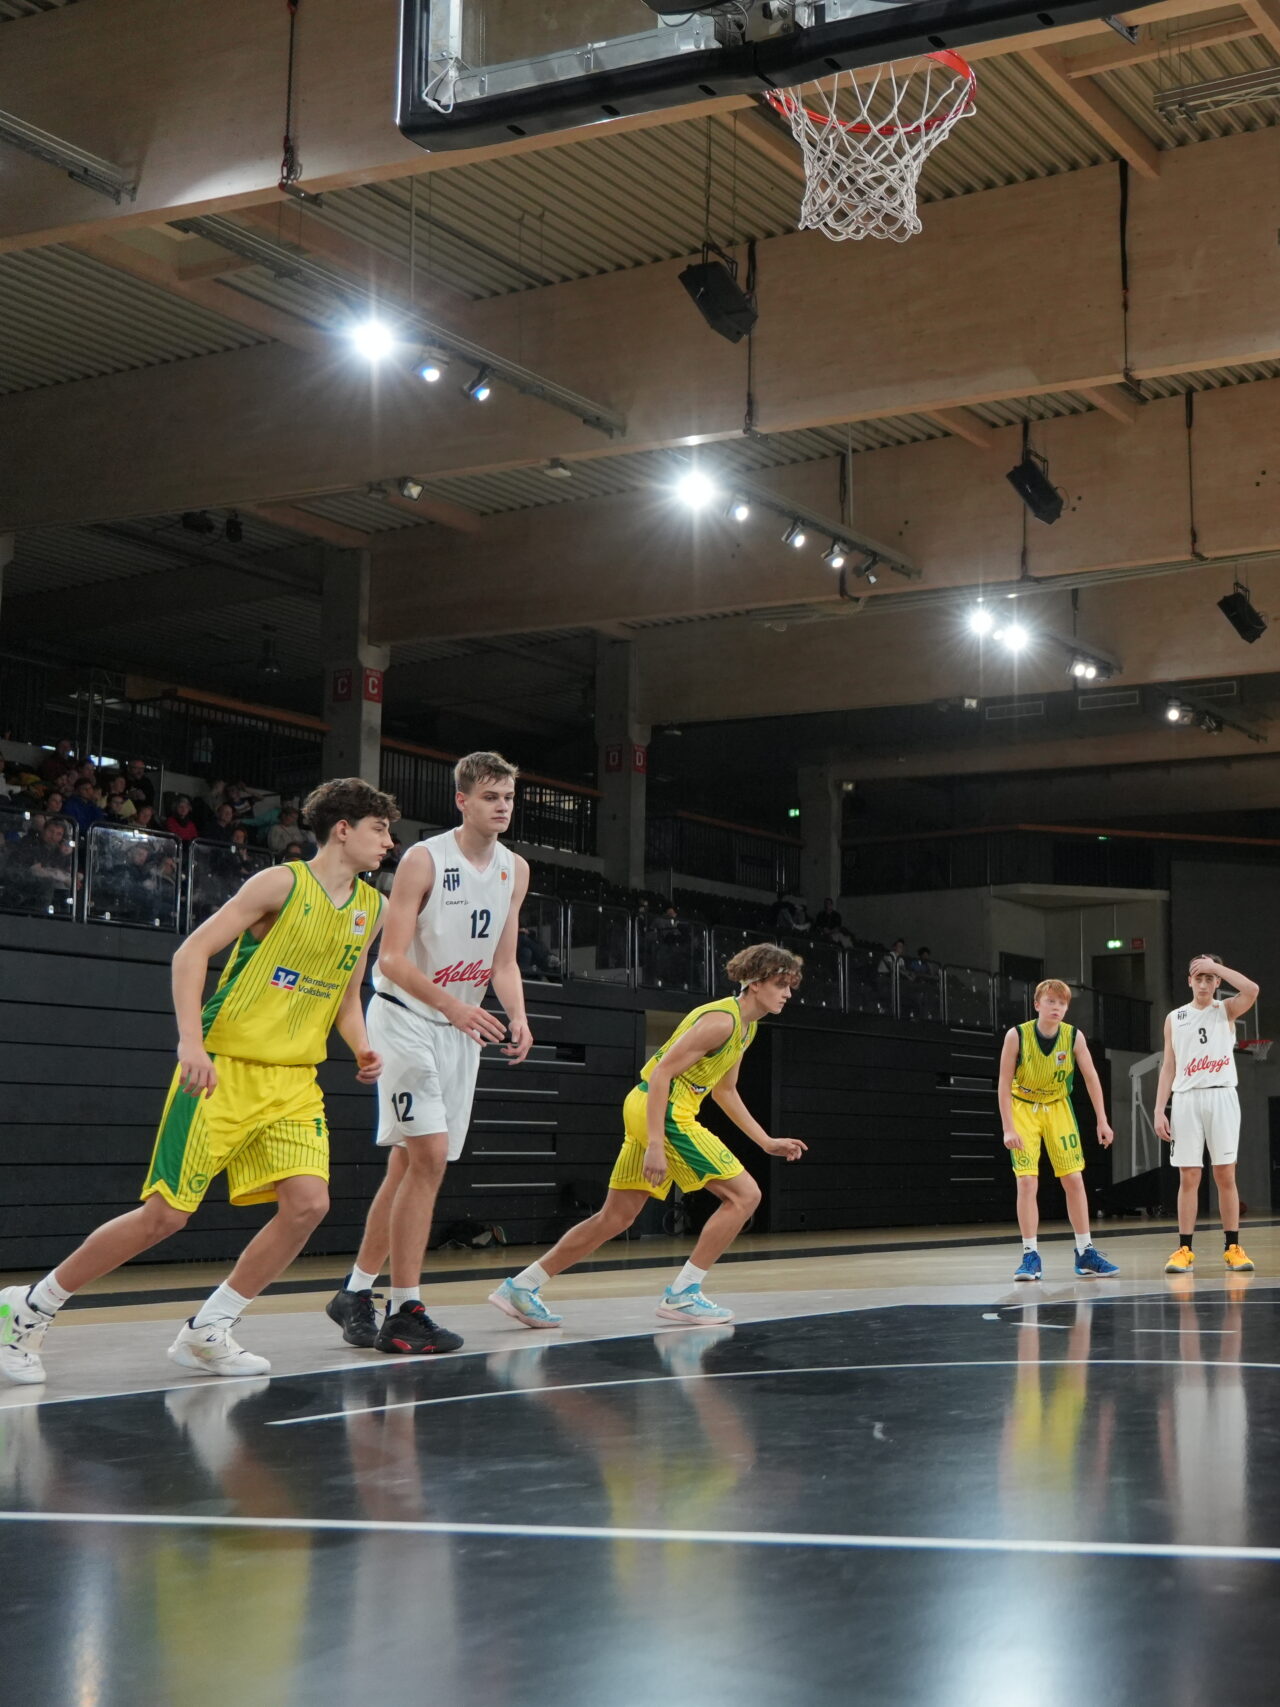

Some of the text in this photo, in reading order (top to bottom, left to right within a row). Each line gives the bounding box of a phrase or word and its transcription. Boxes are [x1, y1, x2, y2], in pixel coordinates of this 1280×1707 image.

[369, 677, 379, 694] C
[470, 908, 492, 939] 12
[336, 943, 362, 972] 15
[1198, 1027, 1208, 1045] 3
[391, 1091, 415, 1123] 12
[1060, 1133, 1078, 1152] 10
